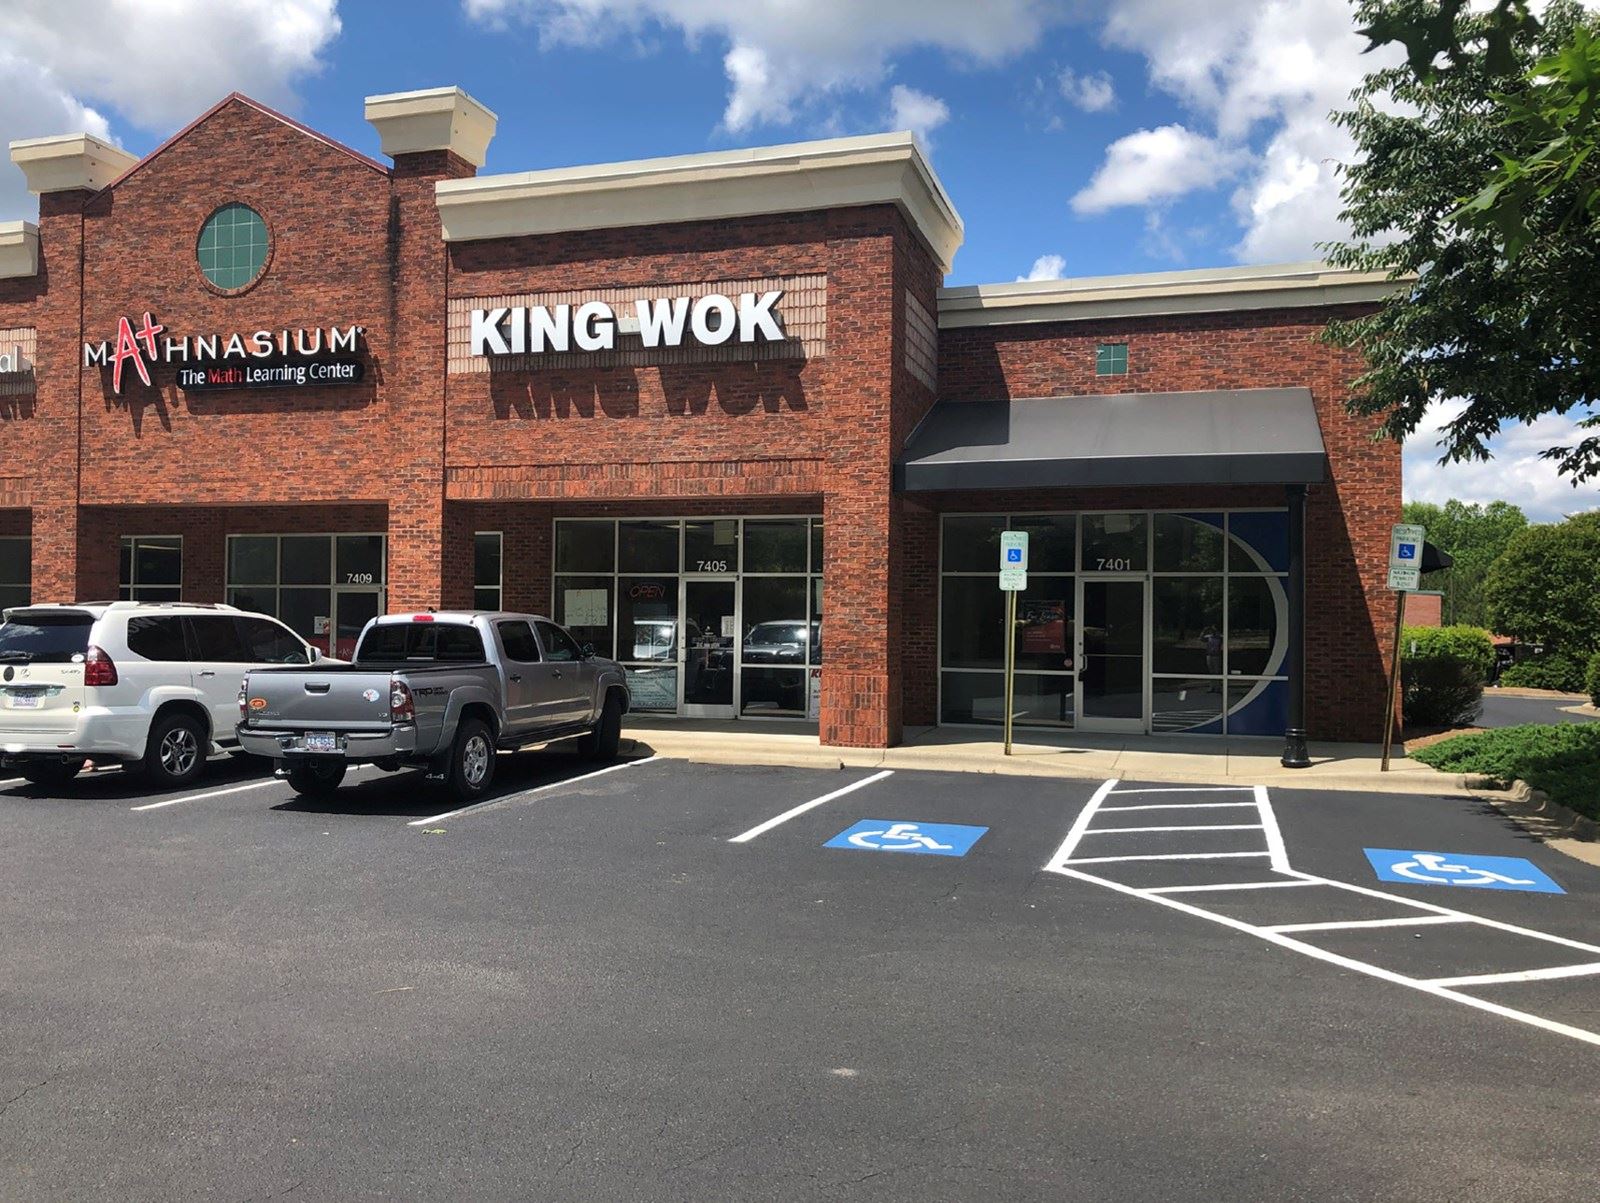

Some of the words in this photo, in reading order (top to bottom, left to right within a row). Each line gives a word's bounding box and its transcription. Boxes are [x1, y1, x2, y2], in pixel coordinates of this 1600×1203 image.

[470, 301, 616, 356] KING
[636, 291, 786, 348] WOK
[180, 370, 205, 386] The
[208, 367, 242, 384] Math
[246, 364, 306, 384] Learning
[309, 362, 356, 380] Center
[696, 560, 727, 572] 7405
[1096, 558, 1131, 571] 7401
[346, 573, 373, 584] 7409
[629, 584, 665, 598] OPEN
